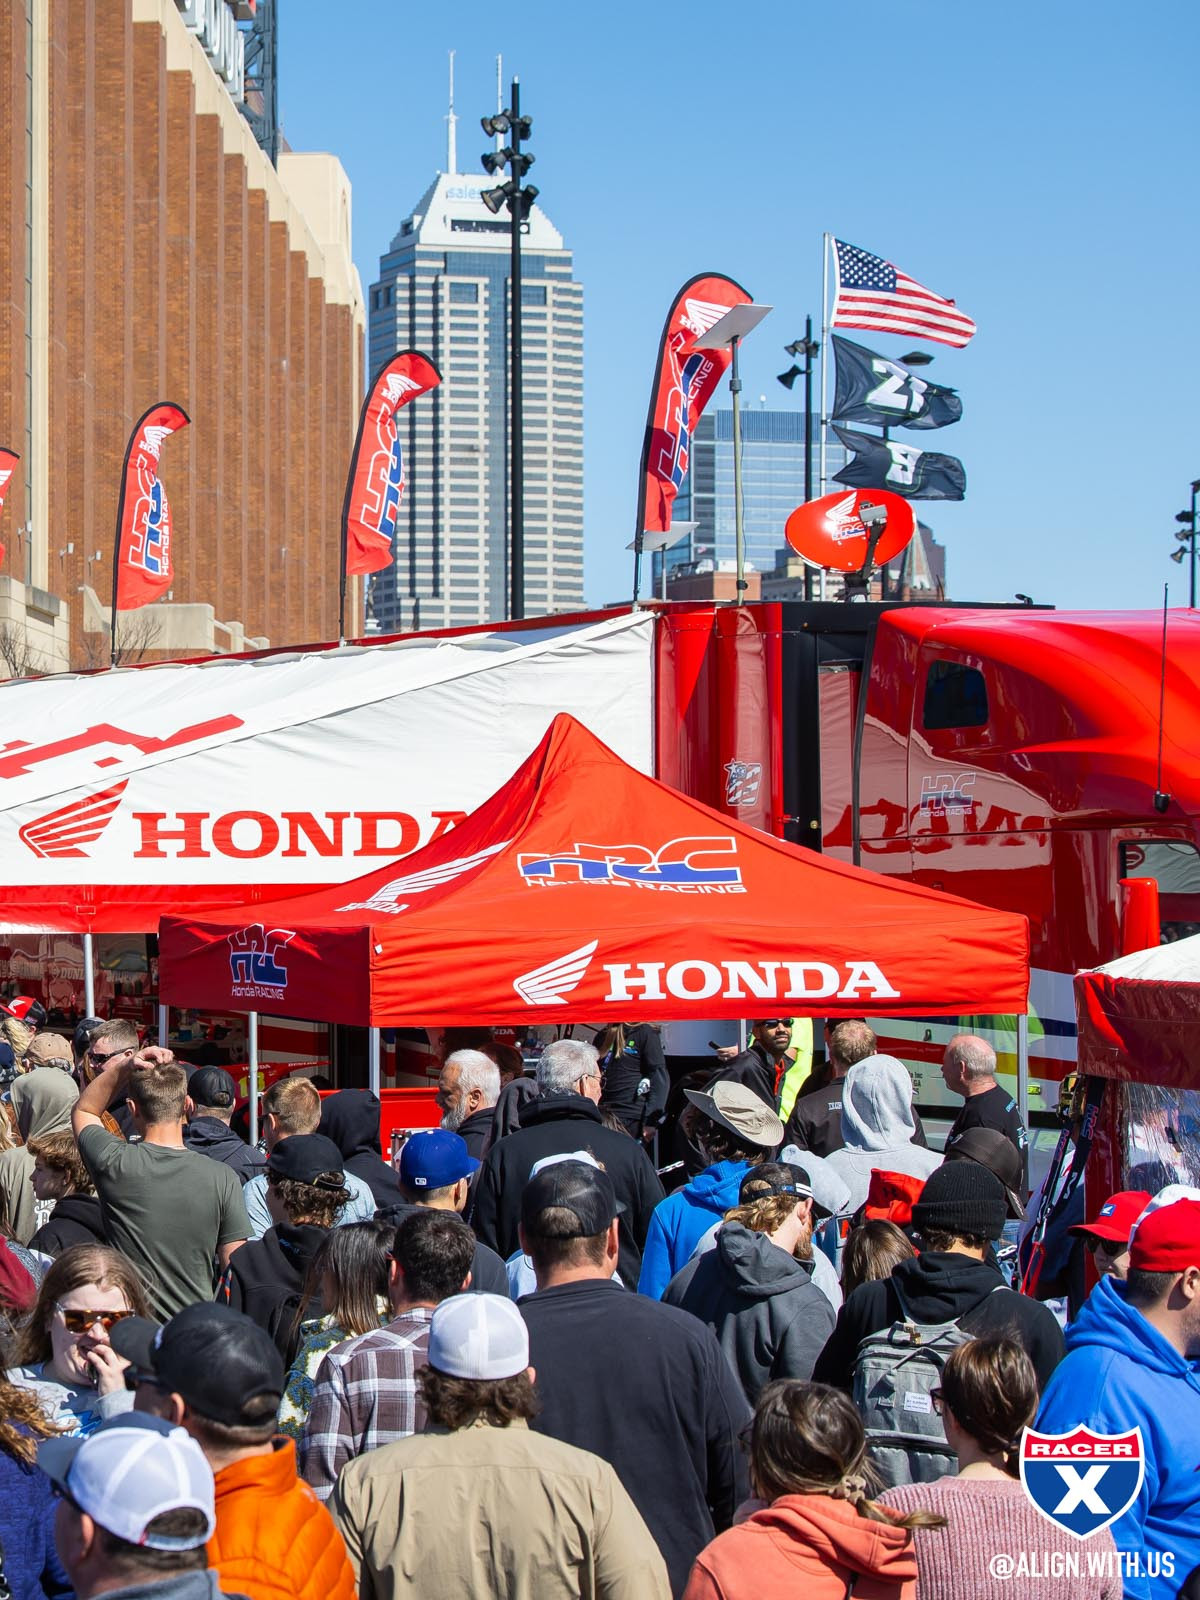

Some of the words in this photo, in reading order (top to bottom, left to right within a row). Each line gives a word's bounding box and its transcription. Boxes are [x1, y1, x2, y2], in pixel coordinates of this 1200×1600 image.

[517, 837, 743, 884] HRC
[635, 881, 747, 895] RACING
[227, 922, 297, 987] HRC
[603, 960, 901, 1002] HONDA
